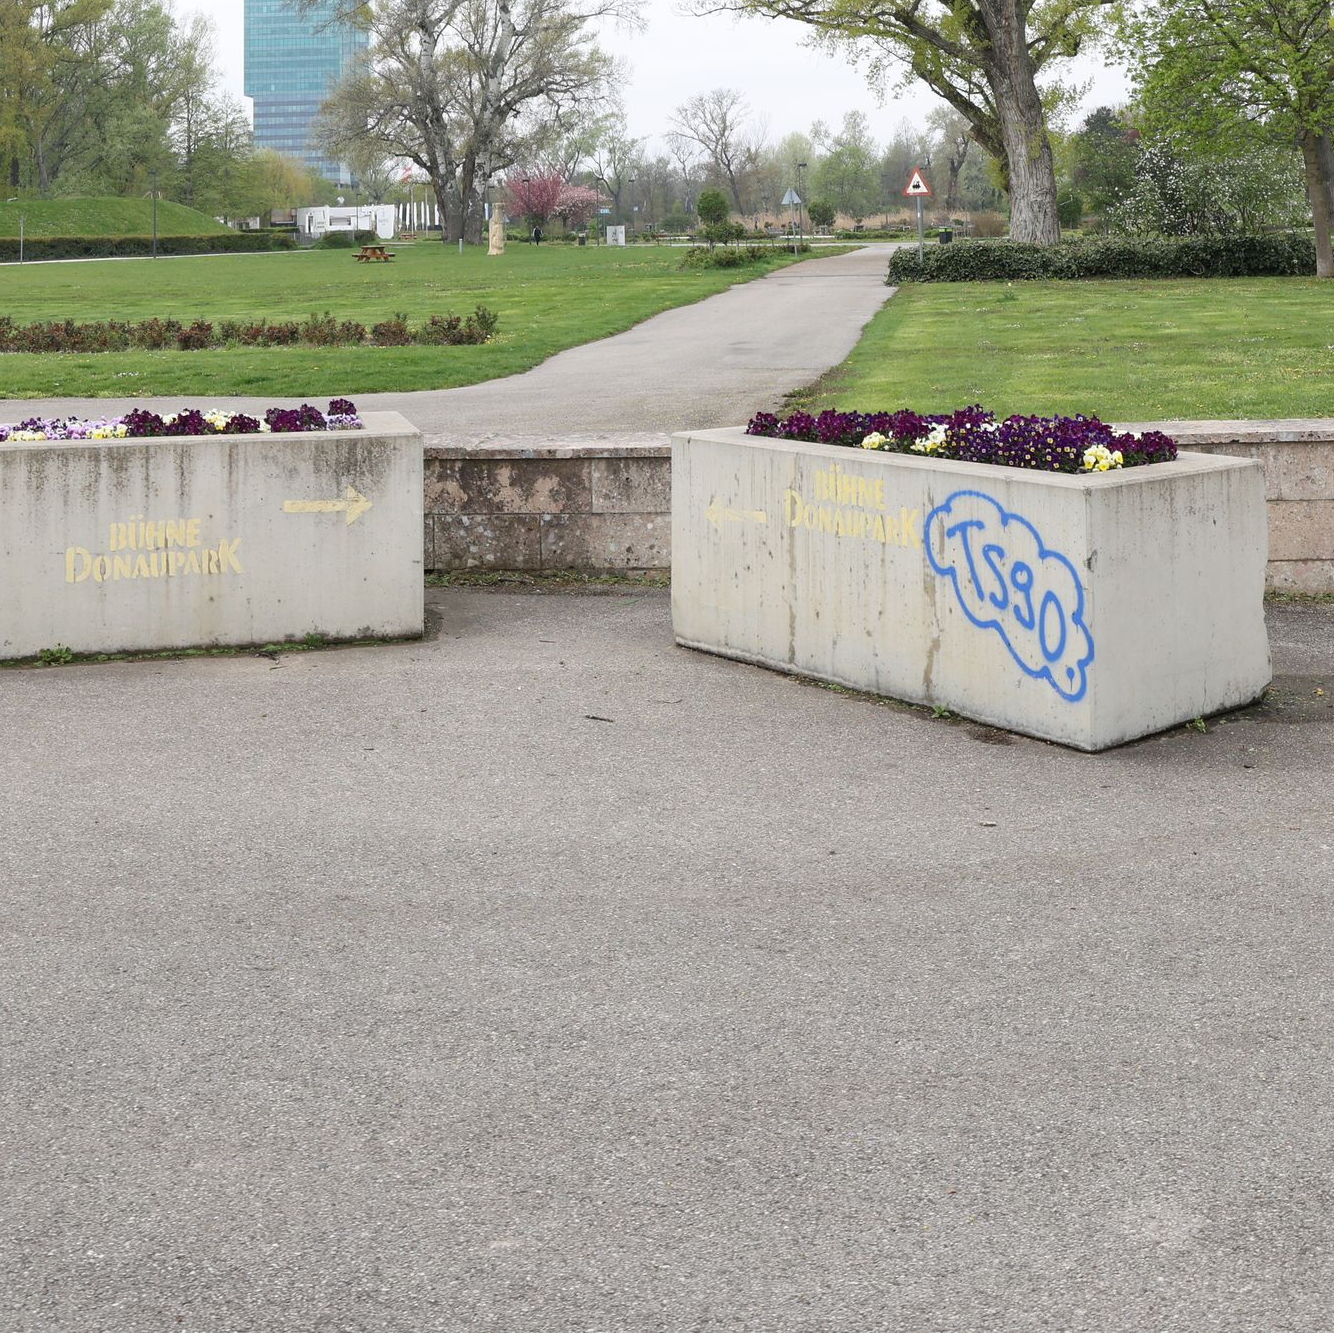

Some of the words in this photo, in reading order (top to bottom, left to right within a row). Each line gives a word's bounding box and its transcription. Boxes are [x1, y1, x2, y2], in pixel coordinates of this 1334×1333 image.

[815, 463, 887, 510] BÜHNE
[109, 514, 203, 551] BÜHNE
[784, 488, 922, 550] DONAUPARK
[65, 537, 244, 584] DONAUPARK
